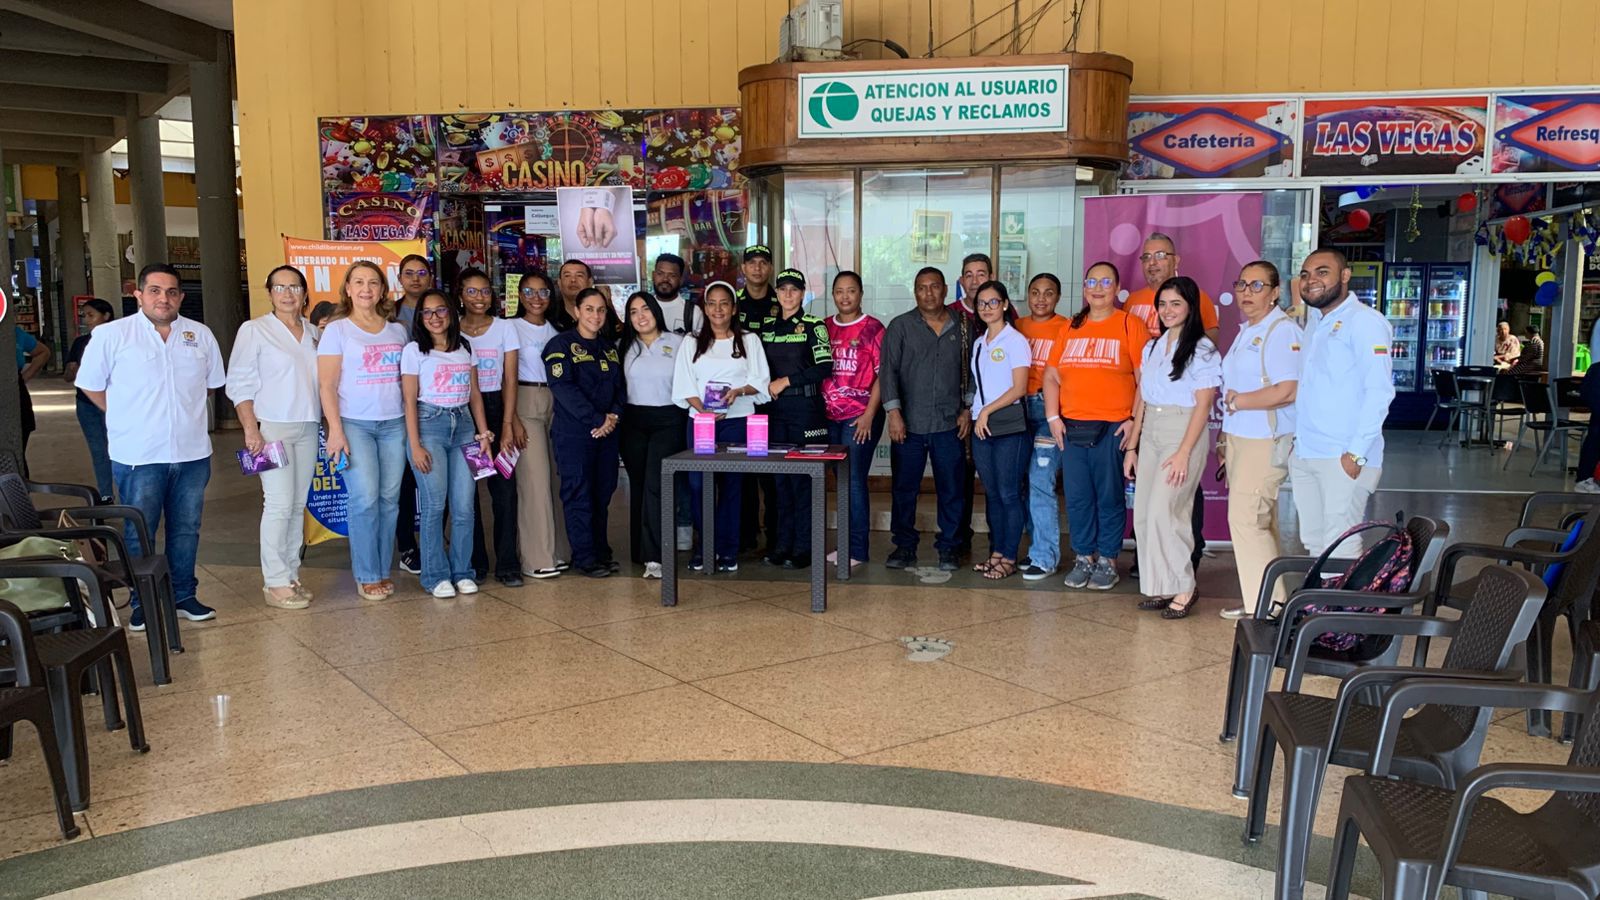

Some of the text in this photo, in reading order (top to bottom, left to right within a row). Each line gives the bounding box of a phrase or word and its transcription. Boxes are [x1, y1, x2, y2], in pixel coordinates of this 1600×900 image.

[865, 79, 1058, 100] ATENCION AL USUARIO
[870, 102, 1051, 123] QUEJAS Y RECLAMOS
[1163, 133, 1255, 149] Cafetería
[1312, 119, 1477, 157] LAS VEGAS
[502, 159, 588, 189] CASINO
[339, 196, 421, 218] CASINO
[345, 224, 415, 239] LAS VEGAS
[444, 229, 484, 251] CASINO
[289, 255, 337, 266] LIBERANDO
[339, 256, 350, 266] AL
[313, 476, 342, 492] DEL
[332, 498, 348, 507] inqu
[320, 509, 347, 518] combat
[327, 516, 348, 524] situac
